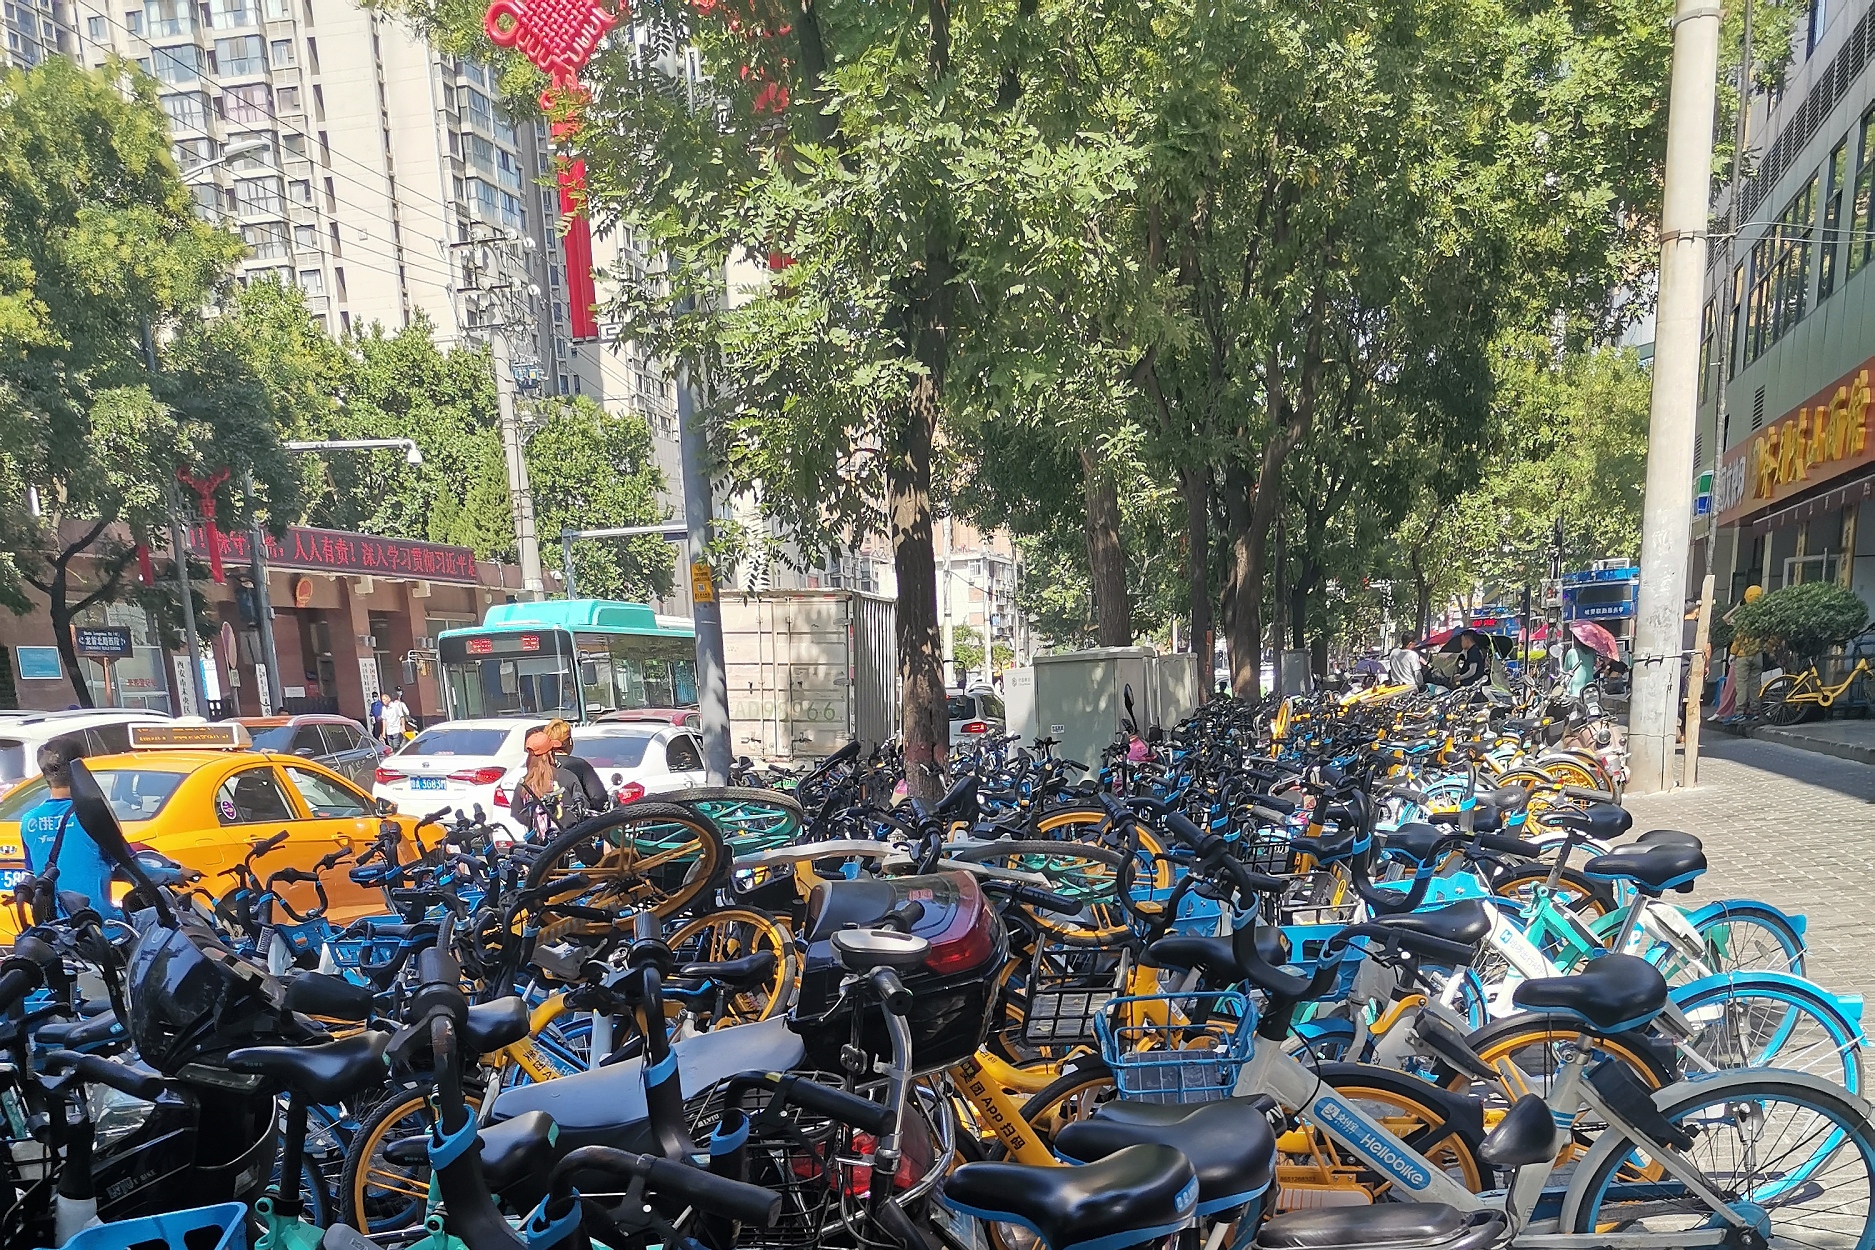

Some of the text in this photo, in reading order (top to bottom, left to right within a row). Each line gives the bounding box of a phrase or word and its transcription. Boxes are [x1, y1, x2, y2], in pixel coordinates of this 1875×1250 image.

[981, 1097, 1004, 1123] App
[1000, 1122, 1026, 1150] 扫码
[1360, 1133, 1424, 1185] Hellobike
